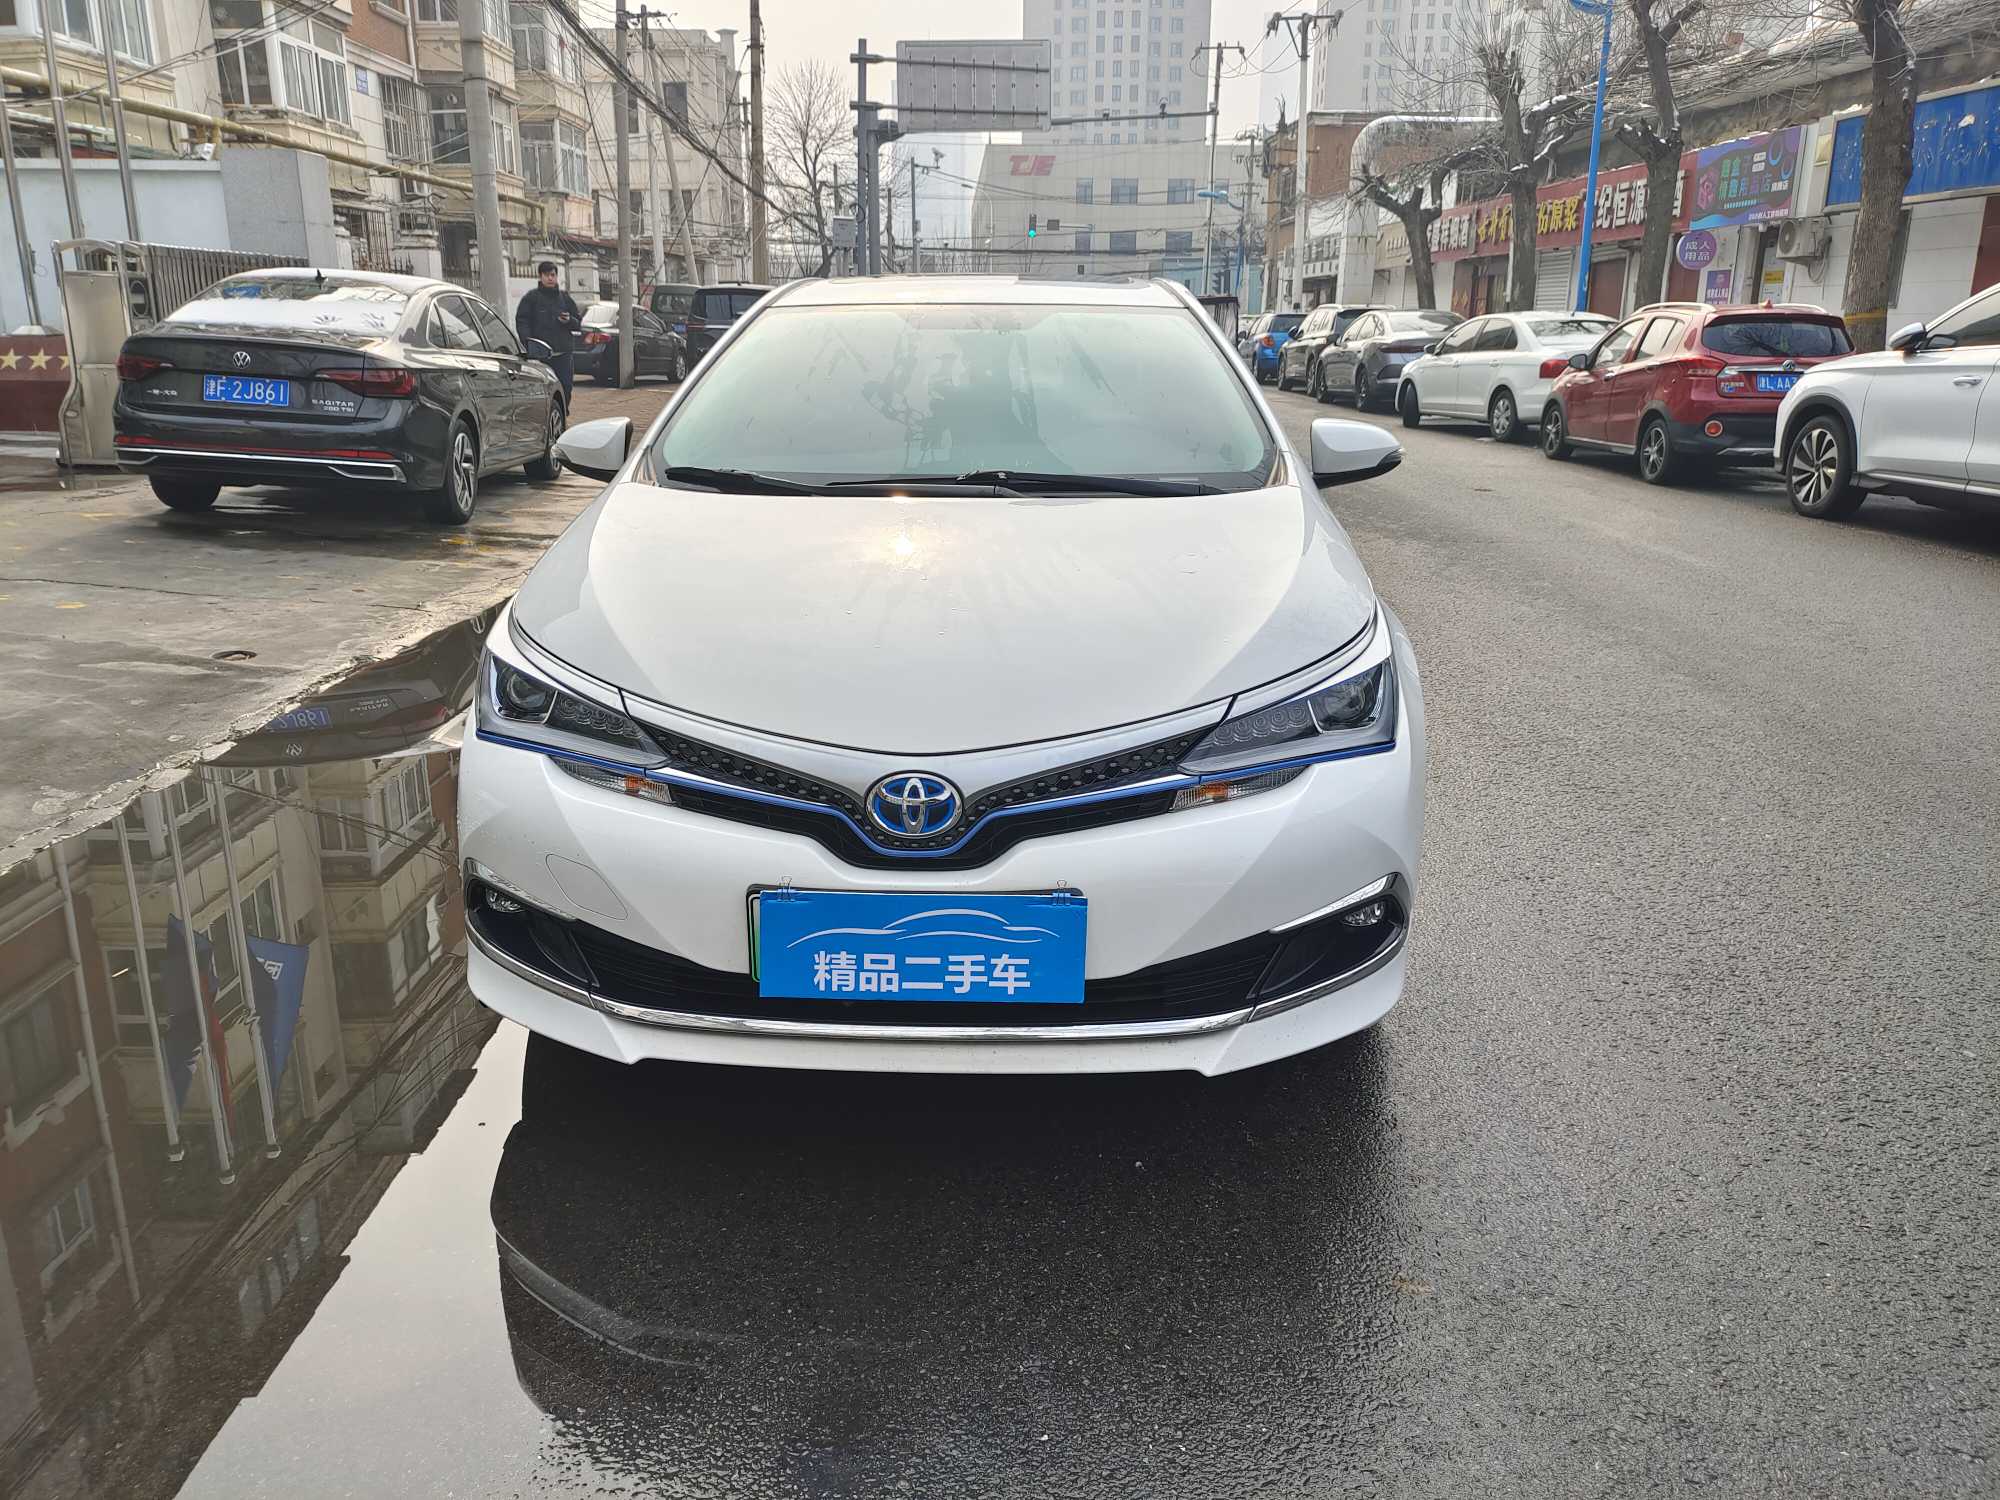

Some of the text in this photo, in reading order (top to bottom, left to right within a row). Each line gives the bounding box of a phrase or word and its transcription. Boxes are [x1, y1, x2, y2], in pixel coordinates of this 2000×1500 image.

[1685, 240, 1711, 250] 成人
[1684, 252, 1710, 261] 用品
[312, 398, 354, 408] SAGITAR
[813, 950, 1031, 995] 精品二手车
